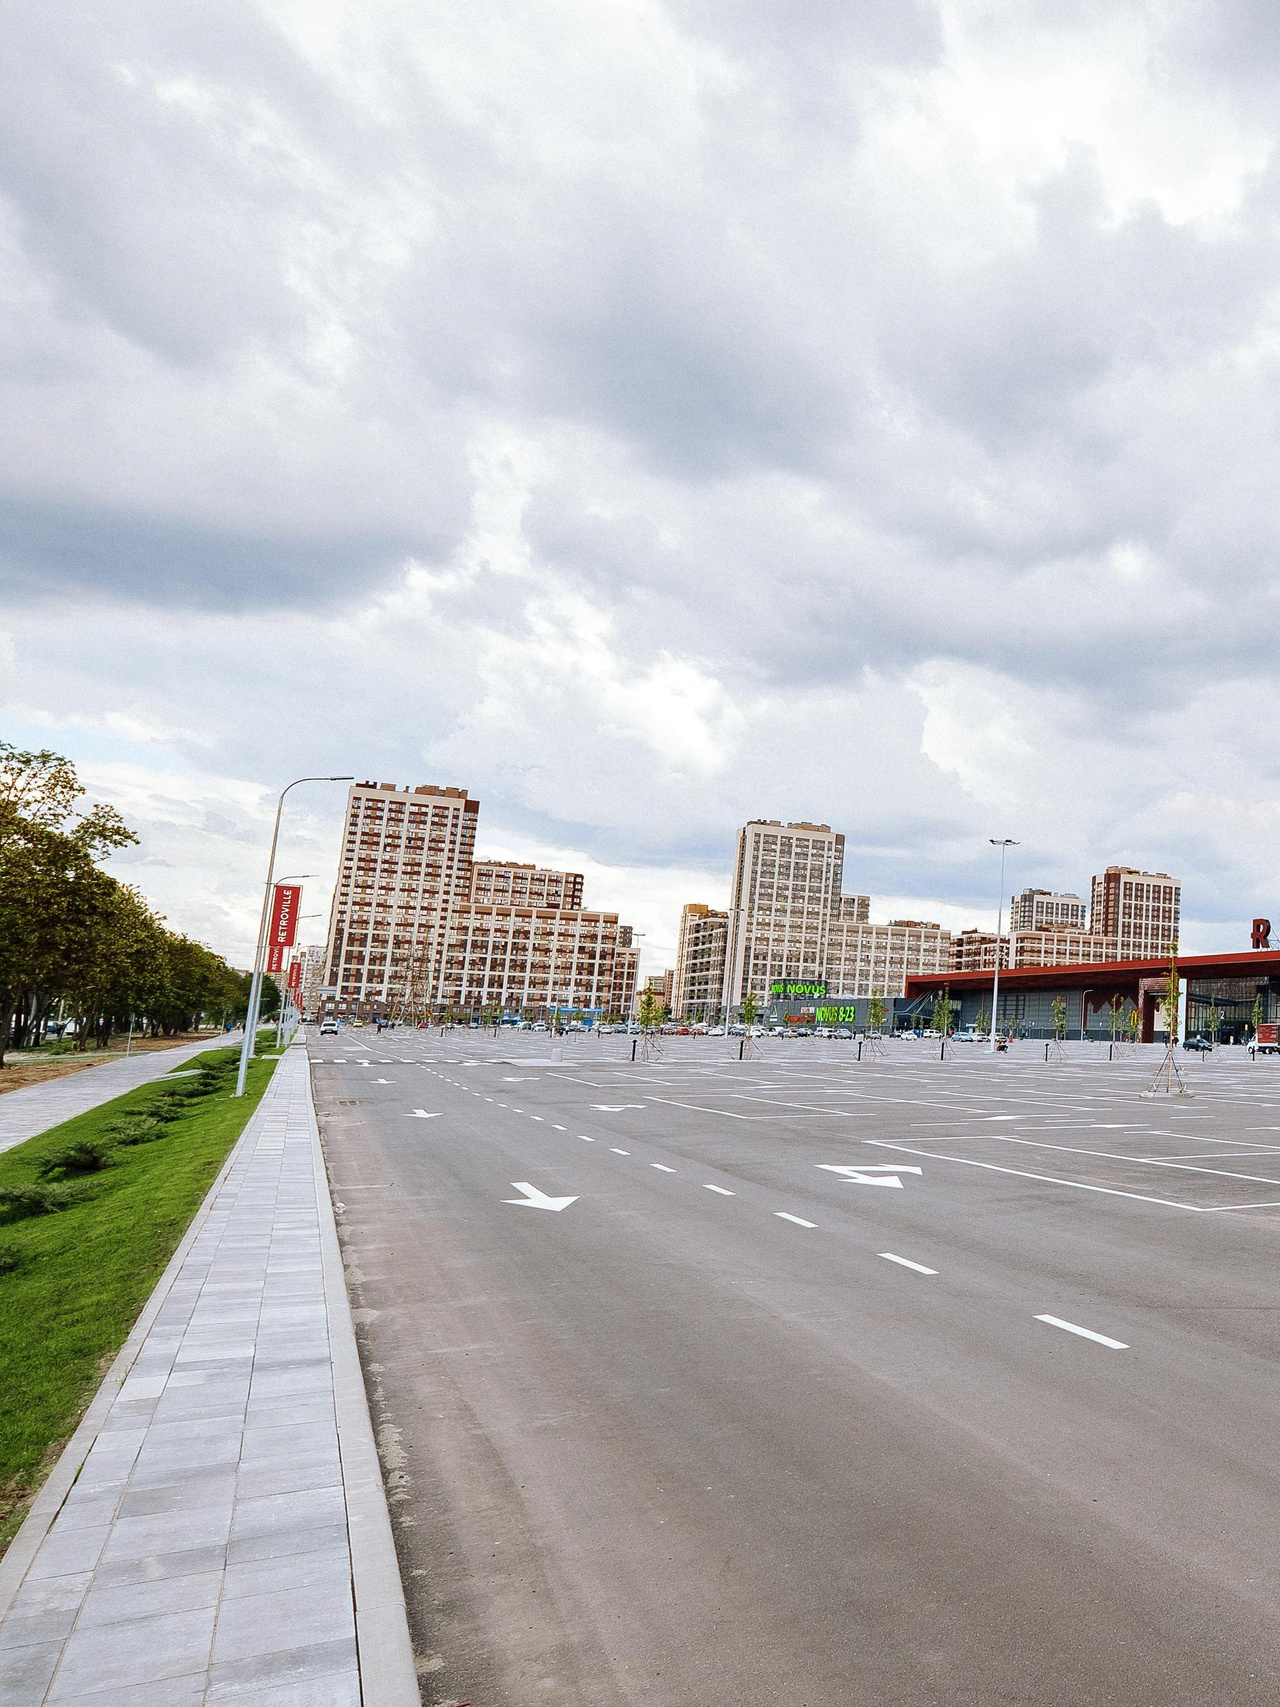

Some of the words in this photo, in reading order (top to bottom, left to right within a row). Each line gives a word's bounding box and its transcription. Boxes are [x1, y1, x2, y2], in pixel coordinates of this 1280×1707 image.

[277, 889, 292, 943] RETROVILLE
[786, 984, 826, 995] NOVUS
[838, 1006, 855, 1022] 8-23
[1220, 1010, 1225, 1020] 2
